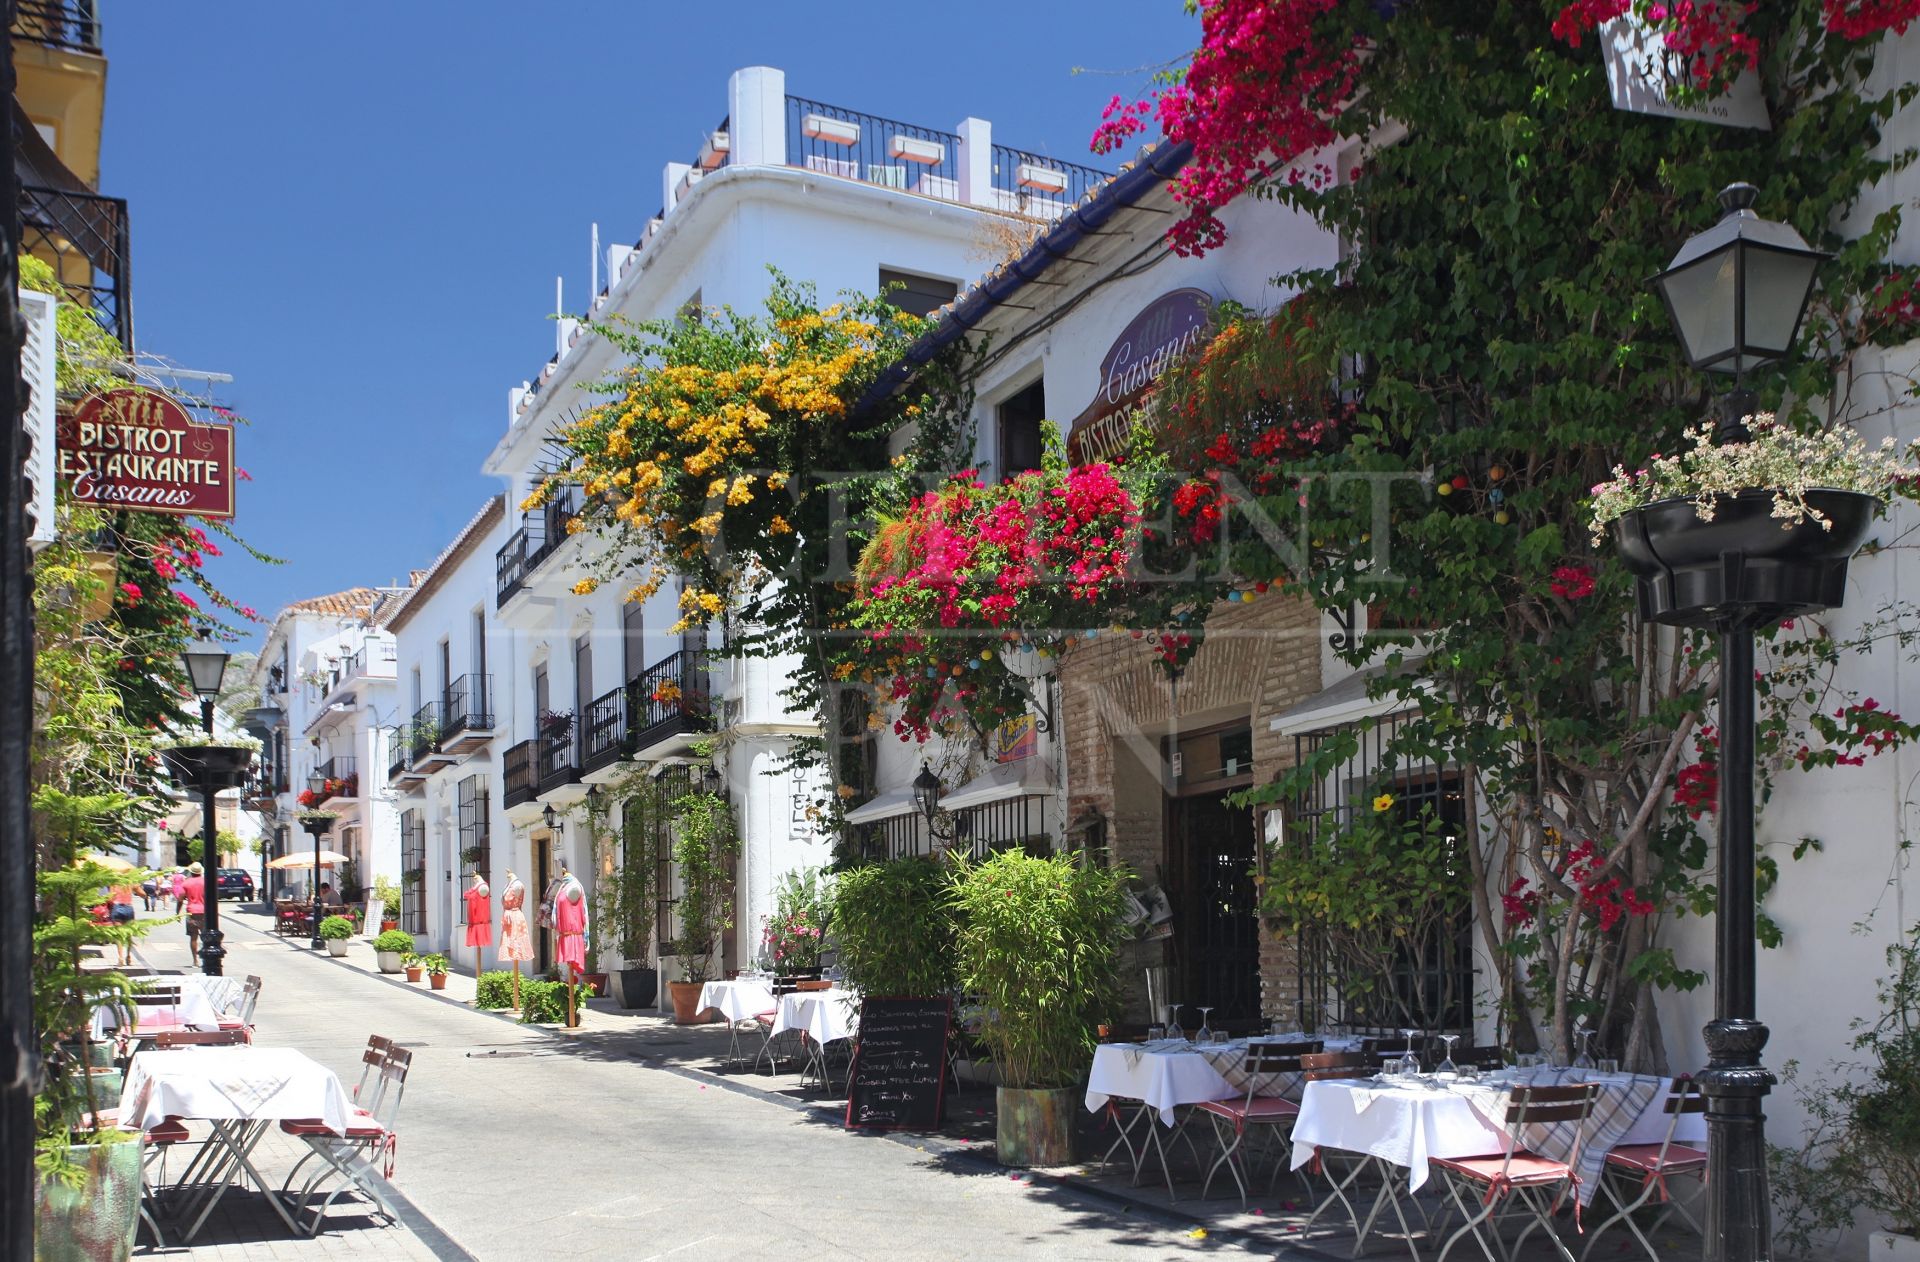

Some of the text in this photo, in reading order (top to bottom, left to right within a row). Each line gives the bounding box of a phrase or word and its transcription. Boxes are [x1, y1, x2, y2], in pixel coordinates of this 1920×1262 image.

[1105, 315, 1200, 404] Casanis
[79, 421, 187, 455] BISTROT
[56, 448, 221, 486] ESTAURANTE
[71, 469, 196, 505] Casanis
[792, 766, 809, 823] OTEL
